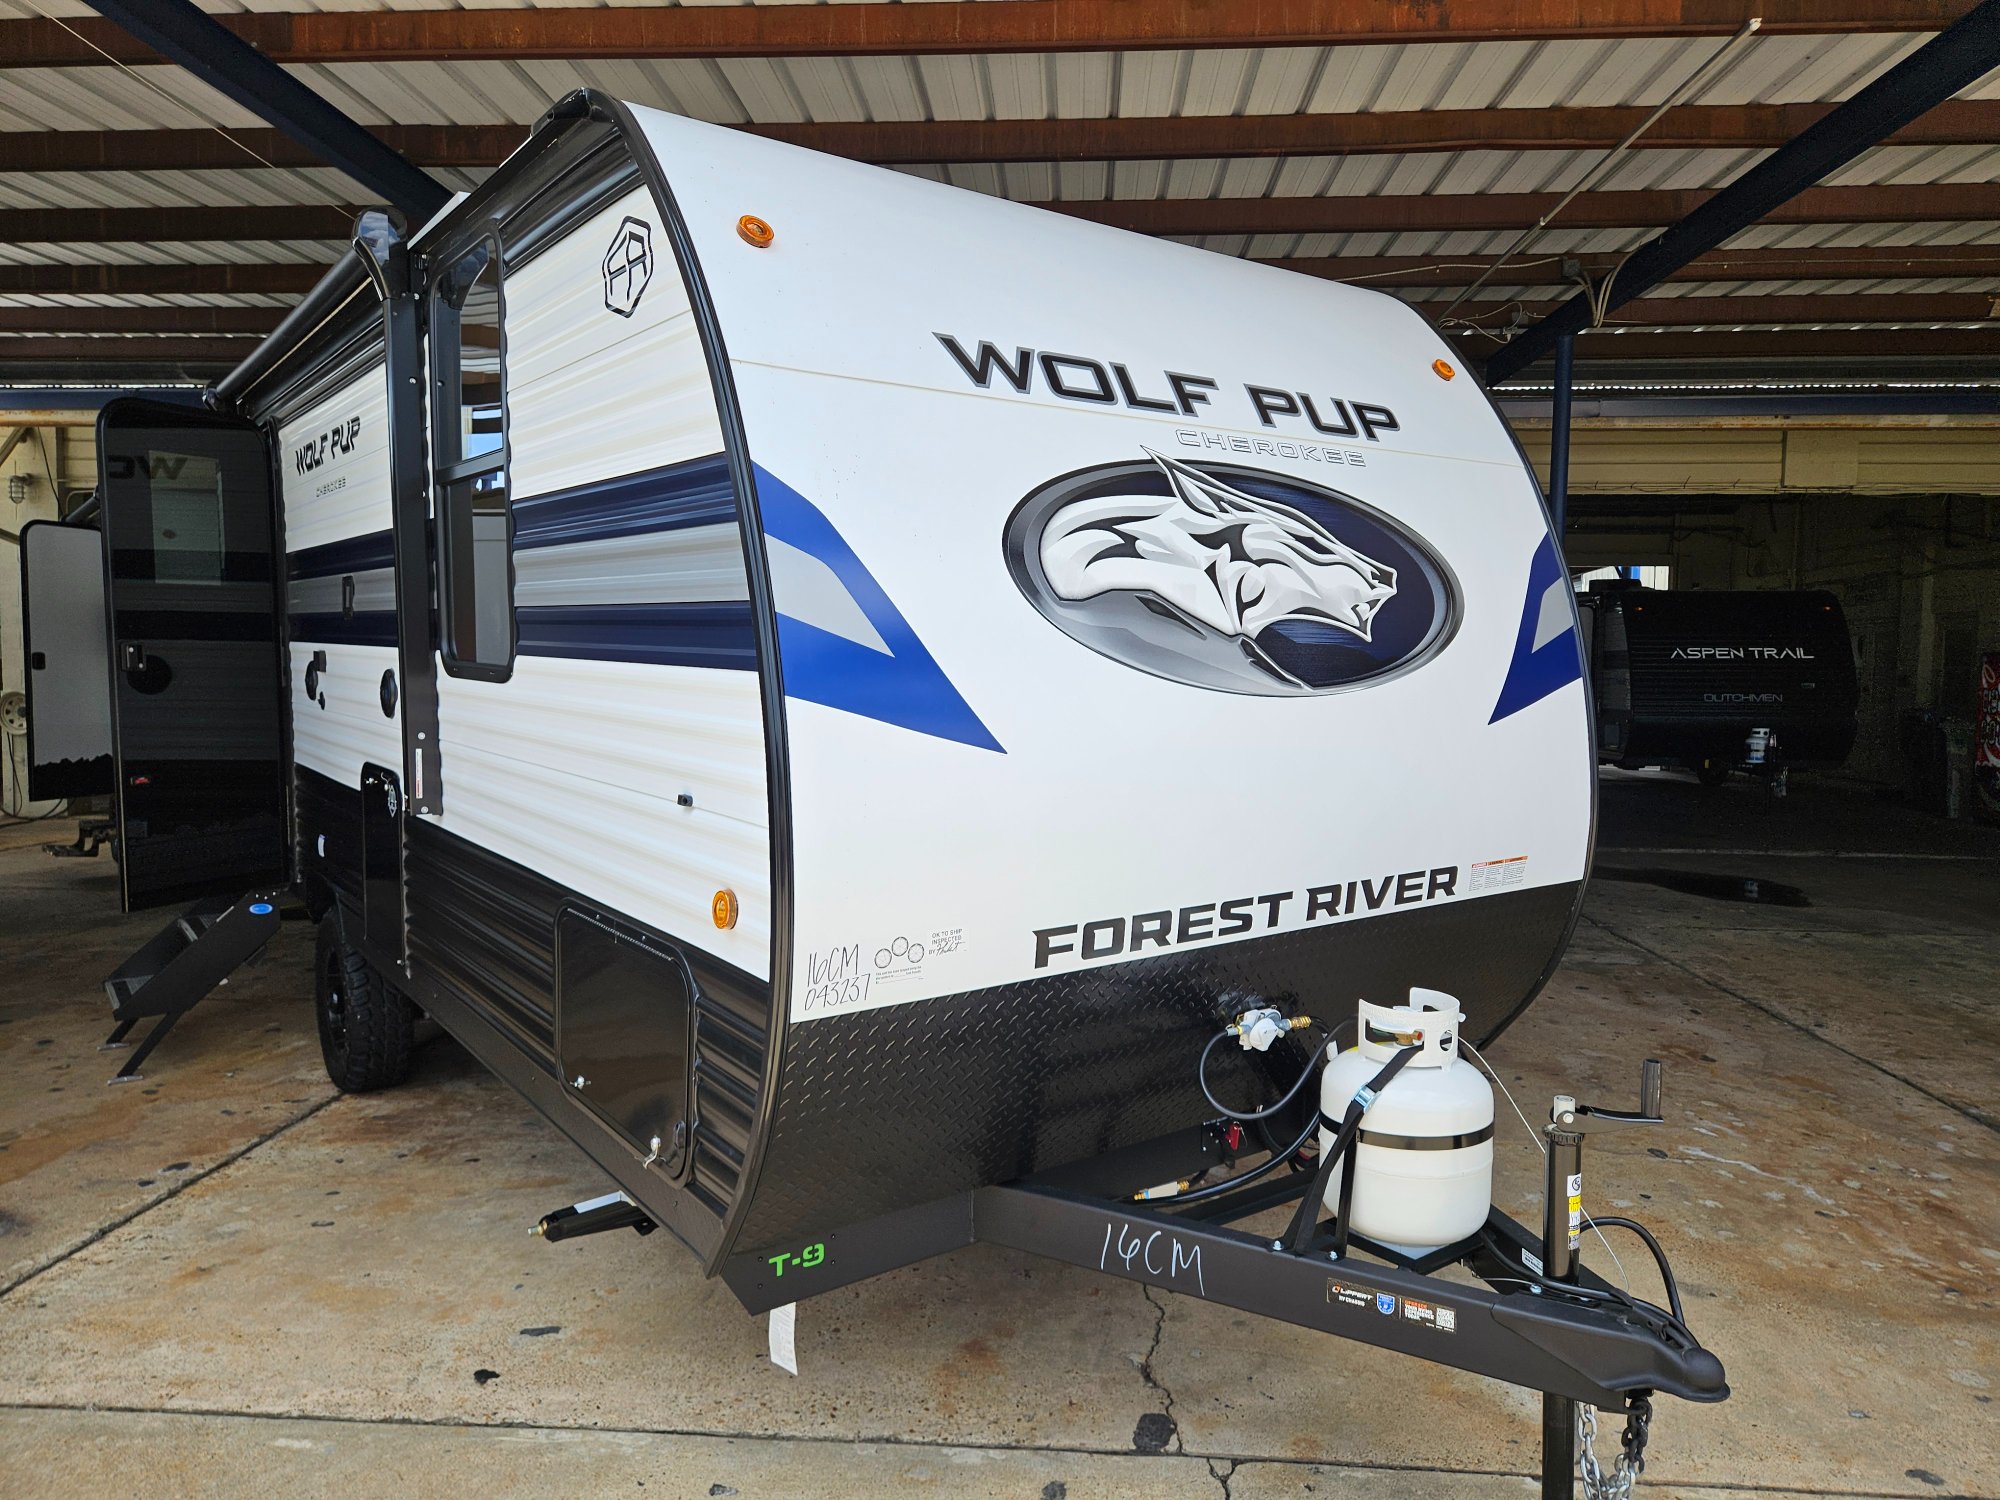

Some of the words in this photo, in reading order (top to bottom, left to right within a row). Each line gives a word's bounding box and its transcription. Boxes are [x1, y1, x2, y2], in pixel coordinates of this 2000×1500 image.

[932, 331, 1219, 417] WOLF
[1244, 383, 1400, 441] PUP
[295, 432, 328, 476] WOLF
[331, 415, 360, 460] PUP
[1175, 429, 1366, 467] CHEROKEE
[1670, 647, 1744, 659] ASPEN
[1748, 647, 1815, 659] TRAIL
[1703, 693, 1783, 702] DUTCHMEN
[1032, 891, 1293, 969] FOREST
[1306, 866, 1458, 922] RIVER
[807, 943, 859, 988] 16CM
[768, 1243, 825, 1277] T-9
[1100, 1223, 1205, 1297] 16CM
